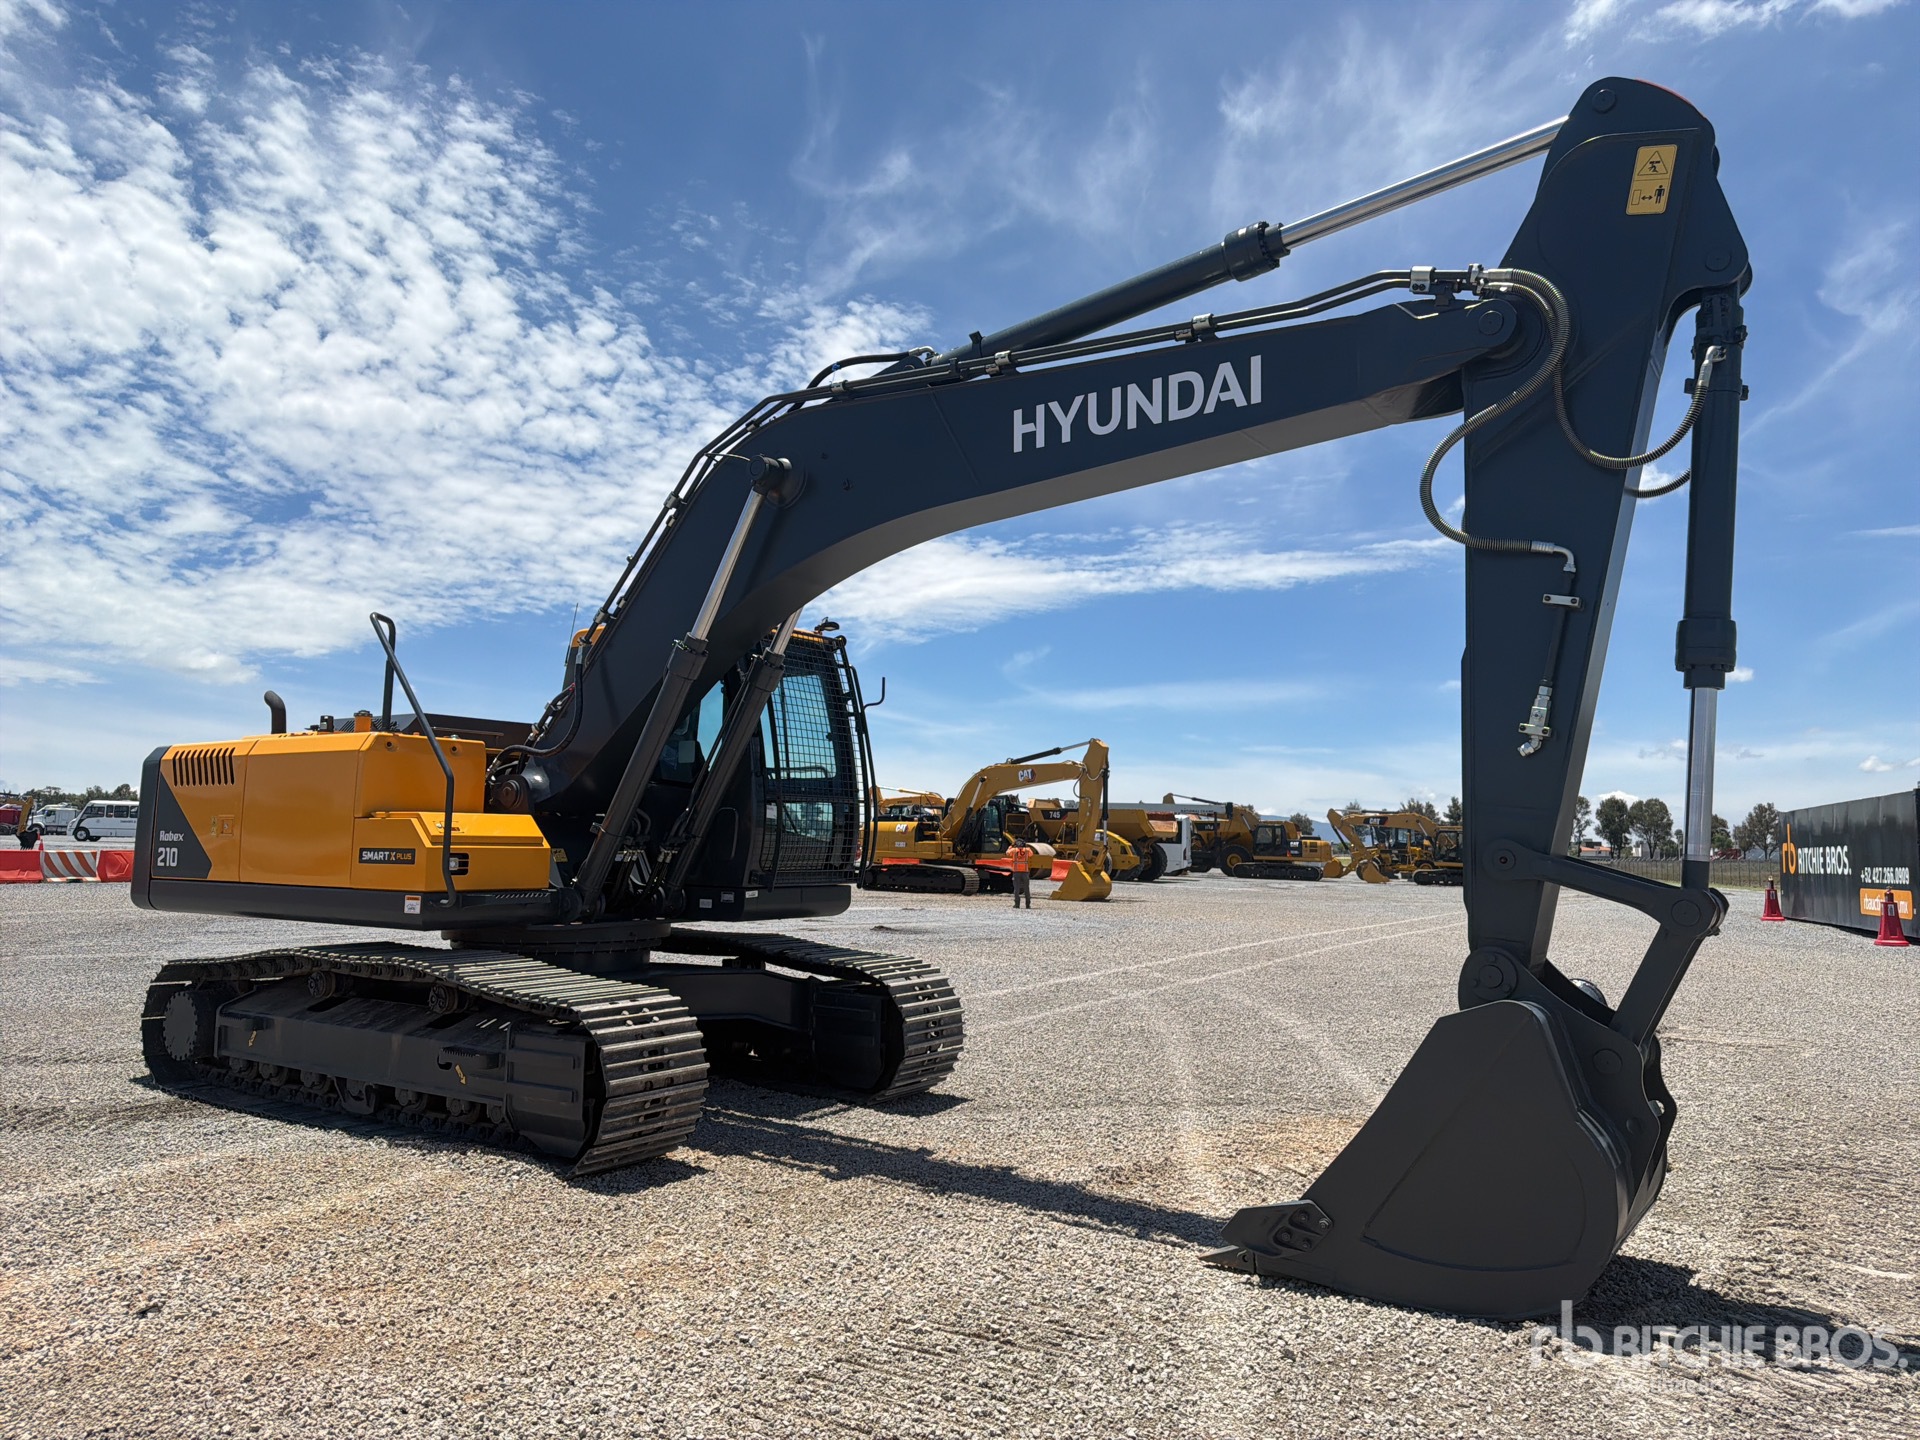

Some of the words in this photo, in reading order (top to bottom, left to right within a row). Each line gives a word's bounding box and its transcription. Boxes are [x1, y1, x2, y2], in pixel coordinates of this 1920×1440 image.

[1013, 354, 1263, 454] HYUNDAI
[1018, 768, 1032, 782] CAT
[1049, 811, 1061, 819] 745
[1369, 817, 1381, 825] CAT
[895, 823, 908, 833] CAT
[159, 830, 185, 842] Robex
[157, 847, 178, 867] 210
[361, 851, 389, 861] SMART
[390, 851, 396, 861] X
[396, 852, 412, 860] PLUS
[1797, 846, 1825, 875] RITCHIE
[1825, 845, 1852, 876] BROS.
[1860, 866, 1872, 883] +52
